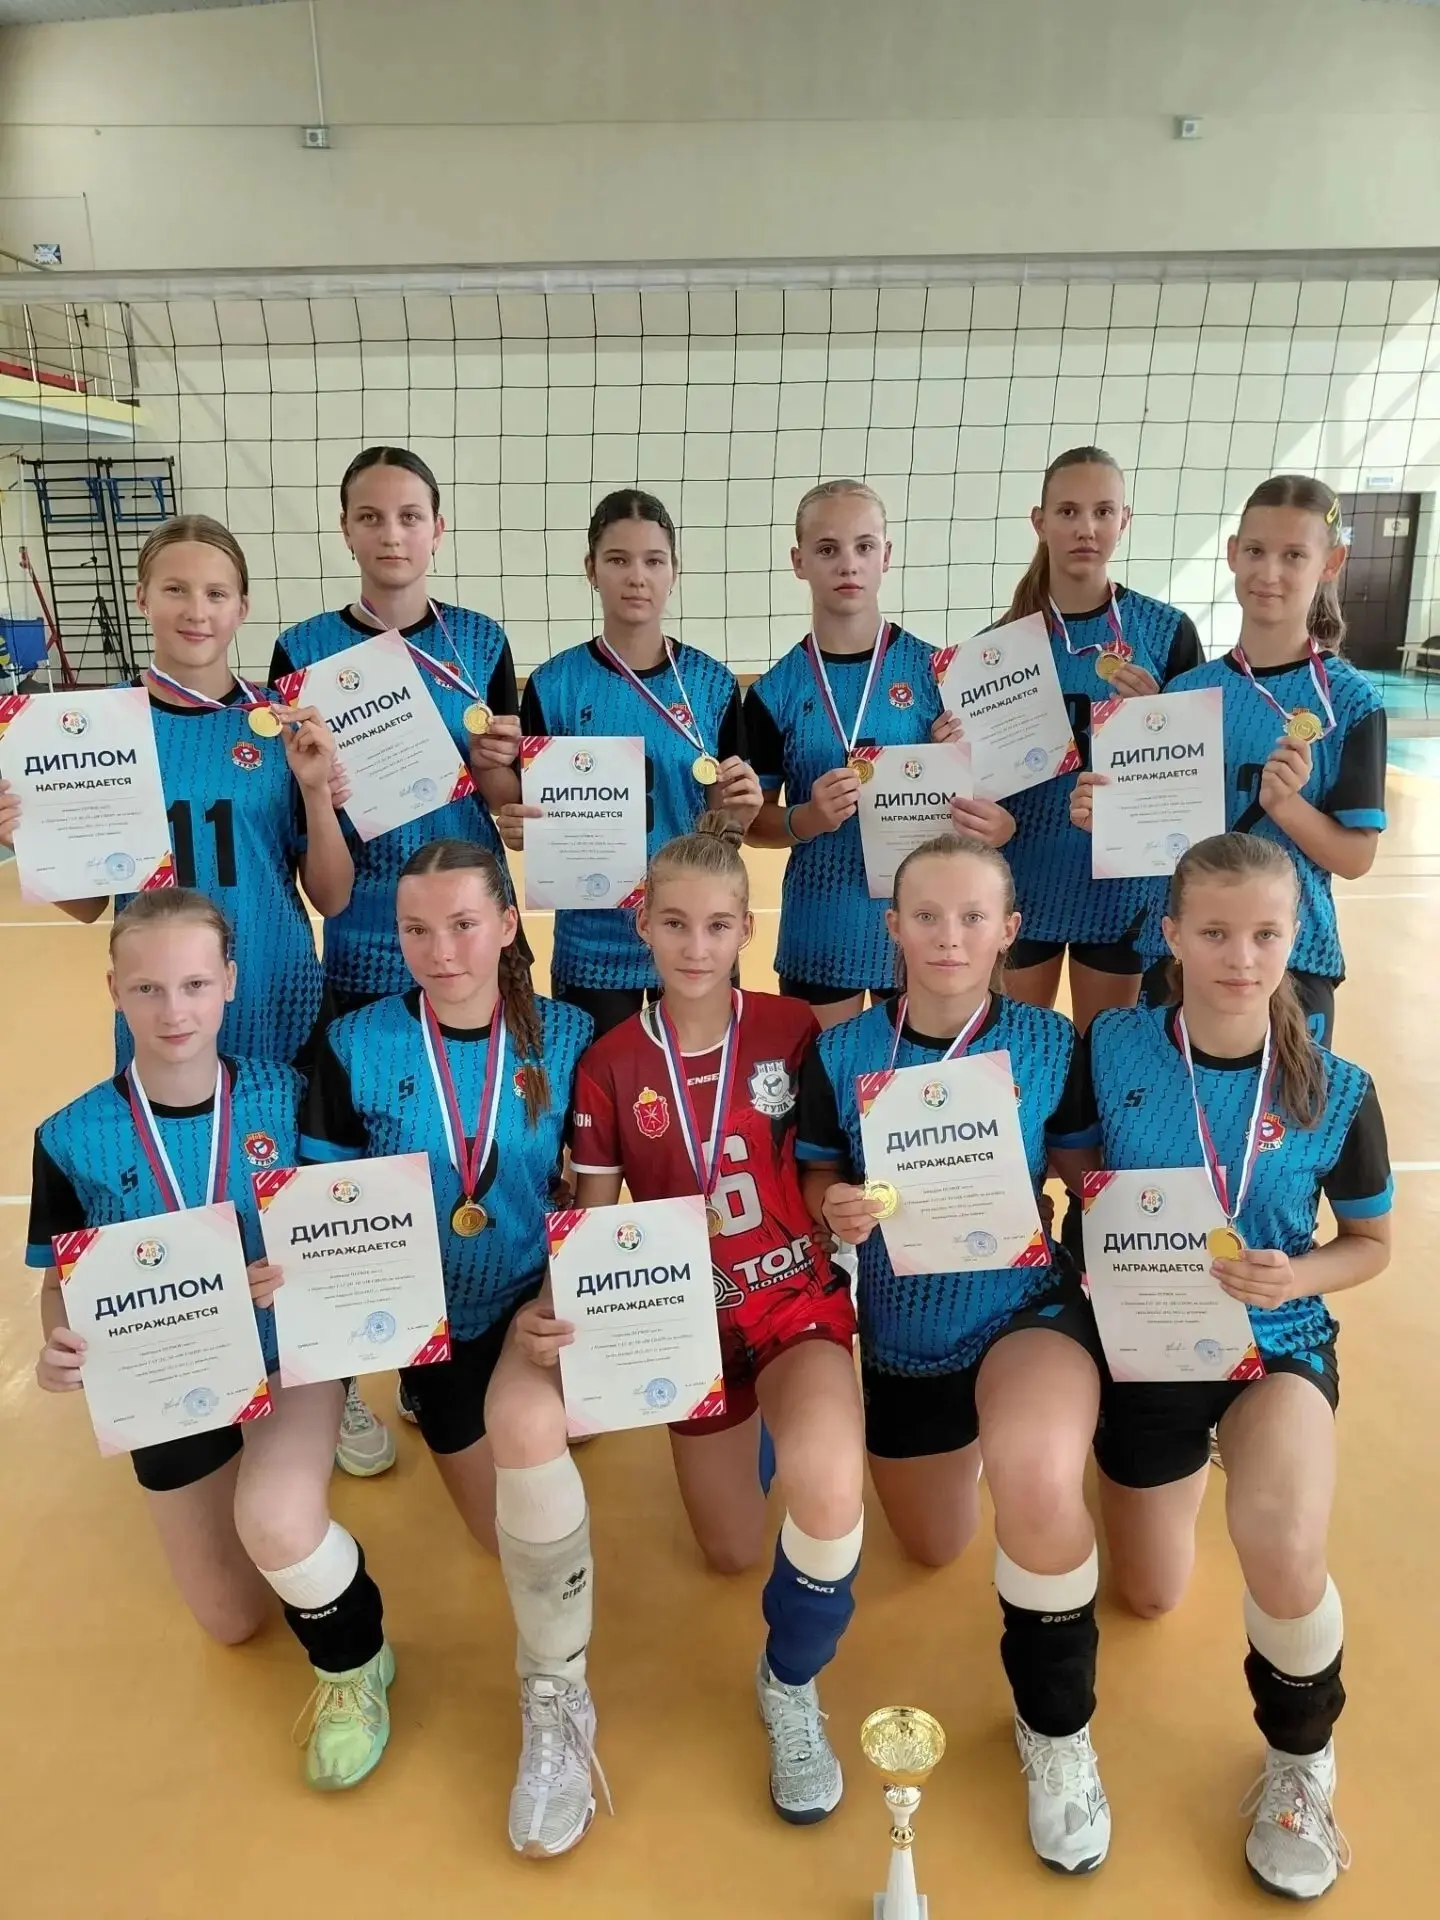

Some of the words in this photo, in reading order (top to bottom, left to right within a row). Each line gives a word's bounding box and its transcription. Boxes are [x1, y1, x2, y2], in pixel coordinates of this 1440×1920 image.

[960, 663, 1041, 708] ДИПЛОМ
[969, 687, 1039, 719] НАГРАЖДАЕТСЯ
[339, 711, 413, 750] НАГРАЖДАЕТСЯ
[24, 749, 137, 775] ДИПЛОМ
[1110, 742, 1205, 769] ДИПЛОМ
[35, 777, 132, 792] НАГРАЖДАЕТСЯ
[1117, 768, 1198, 783] НАГРАЖДАЕТСЯ
[540, 787, 629, 804] ДИПЛОМ
[548, 811, 623, 819] НАГРАЖДАЕТСЯ
[881, 813, 952, 822] НАГРАЖДАЕТСЯ
[166, 798, 238, 888] 11
[762, 1102, 790, 1113] ТУЛА
[886, 1119, 999, 1154] ДИПЛОМ
[897, 1151, 994, 1172] НАГРАЖДАЕТСЯ
[702, 1134, 764, 1237] 6
[290, 1212, 413, 1246] ДИПЛОМ
[302, 1239, 407, 1260] НАГРАЖДАЕТСЯ
[1103, 1232, 1208, 1254] ДИПЛОМ
[576, 1263, 691, 1298] ДИПЛОМ
[1112, 1263, 1204, 1273] НАГРАЖДАЕТСЯ
[94, 1273, 224, 1320] ДИПЛОМ
[586, 1295, 685, 1315] НАГРАЖДАЕТСЯ
[108, 1306, 219, 1338] НАГРАЖДАЕТСЯ
